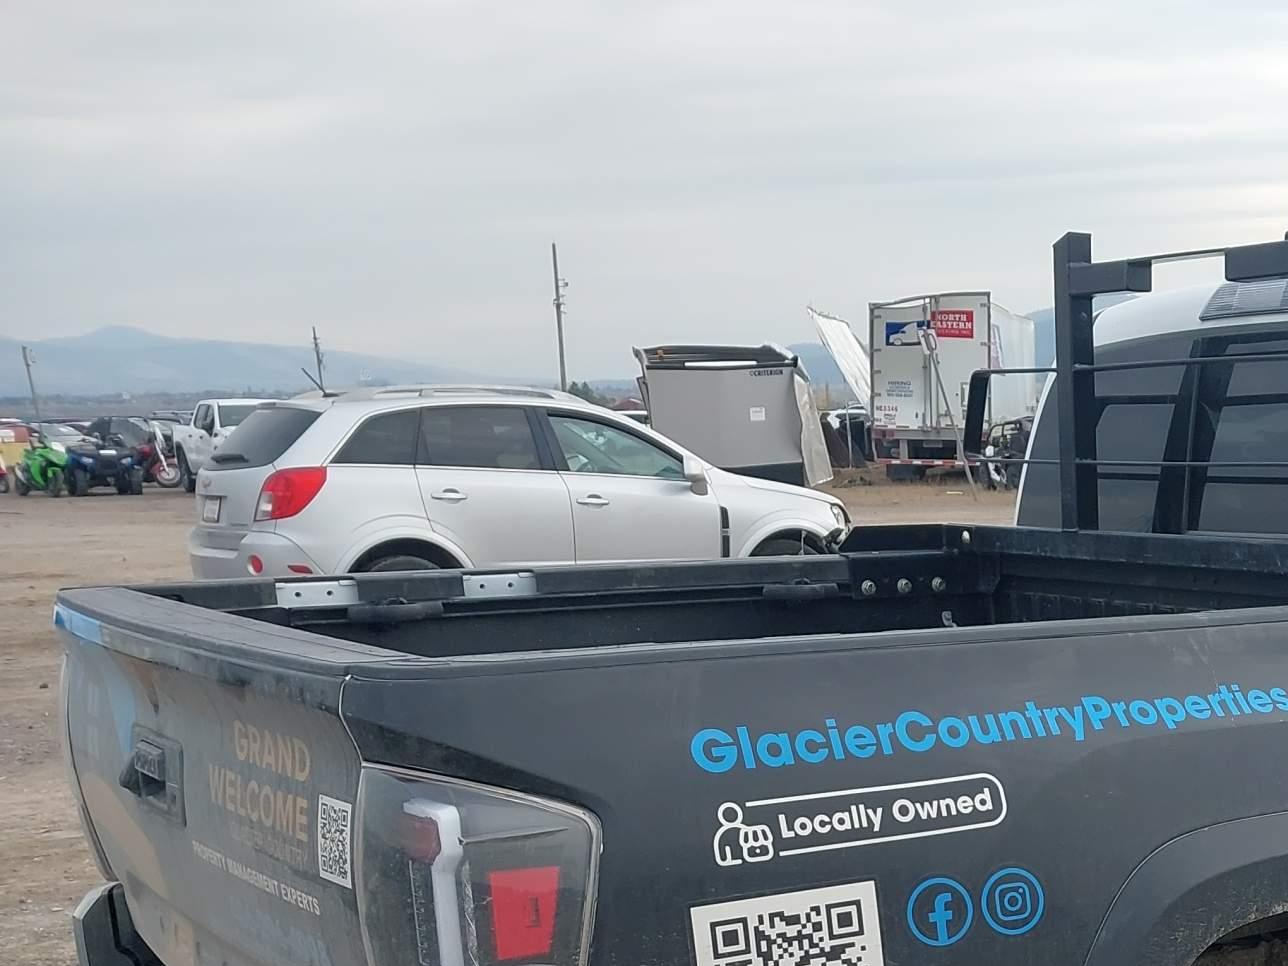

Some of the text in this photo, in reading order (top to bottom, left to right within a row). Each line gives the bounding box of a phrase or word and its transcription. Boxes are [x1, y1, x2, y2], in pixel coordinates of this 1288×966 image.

[232, 719, 311, 782] GRAND
[208, 763, 308, 842] WELCOME
[779, 788, 993, 840] Locally Owned
[191, 839, 320, 916] PROPERTY MANAGEMENT EXPERTS
